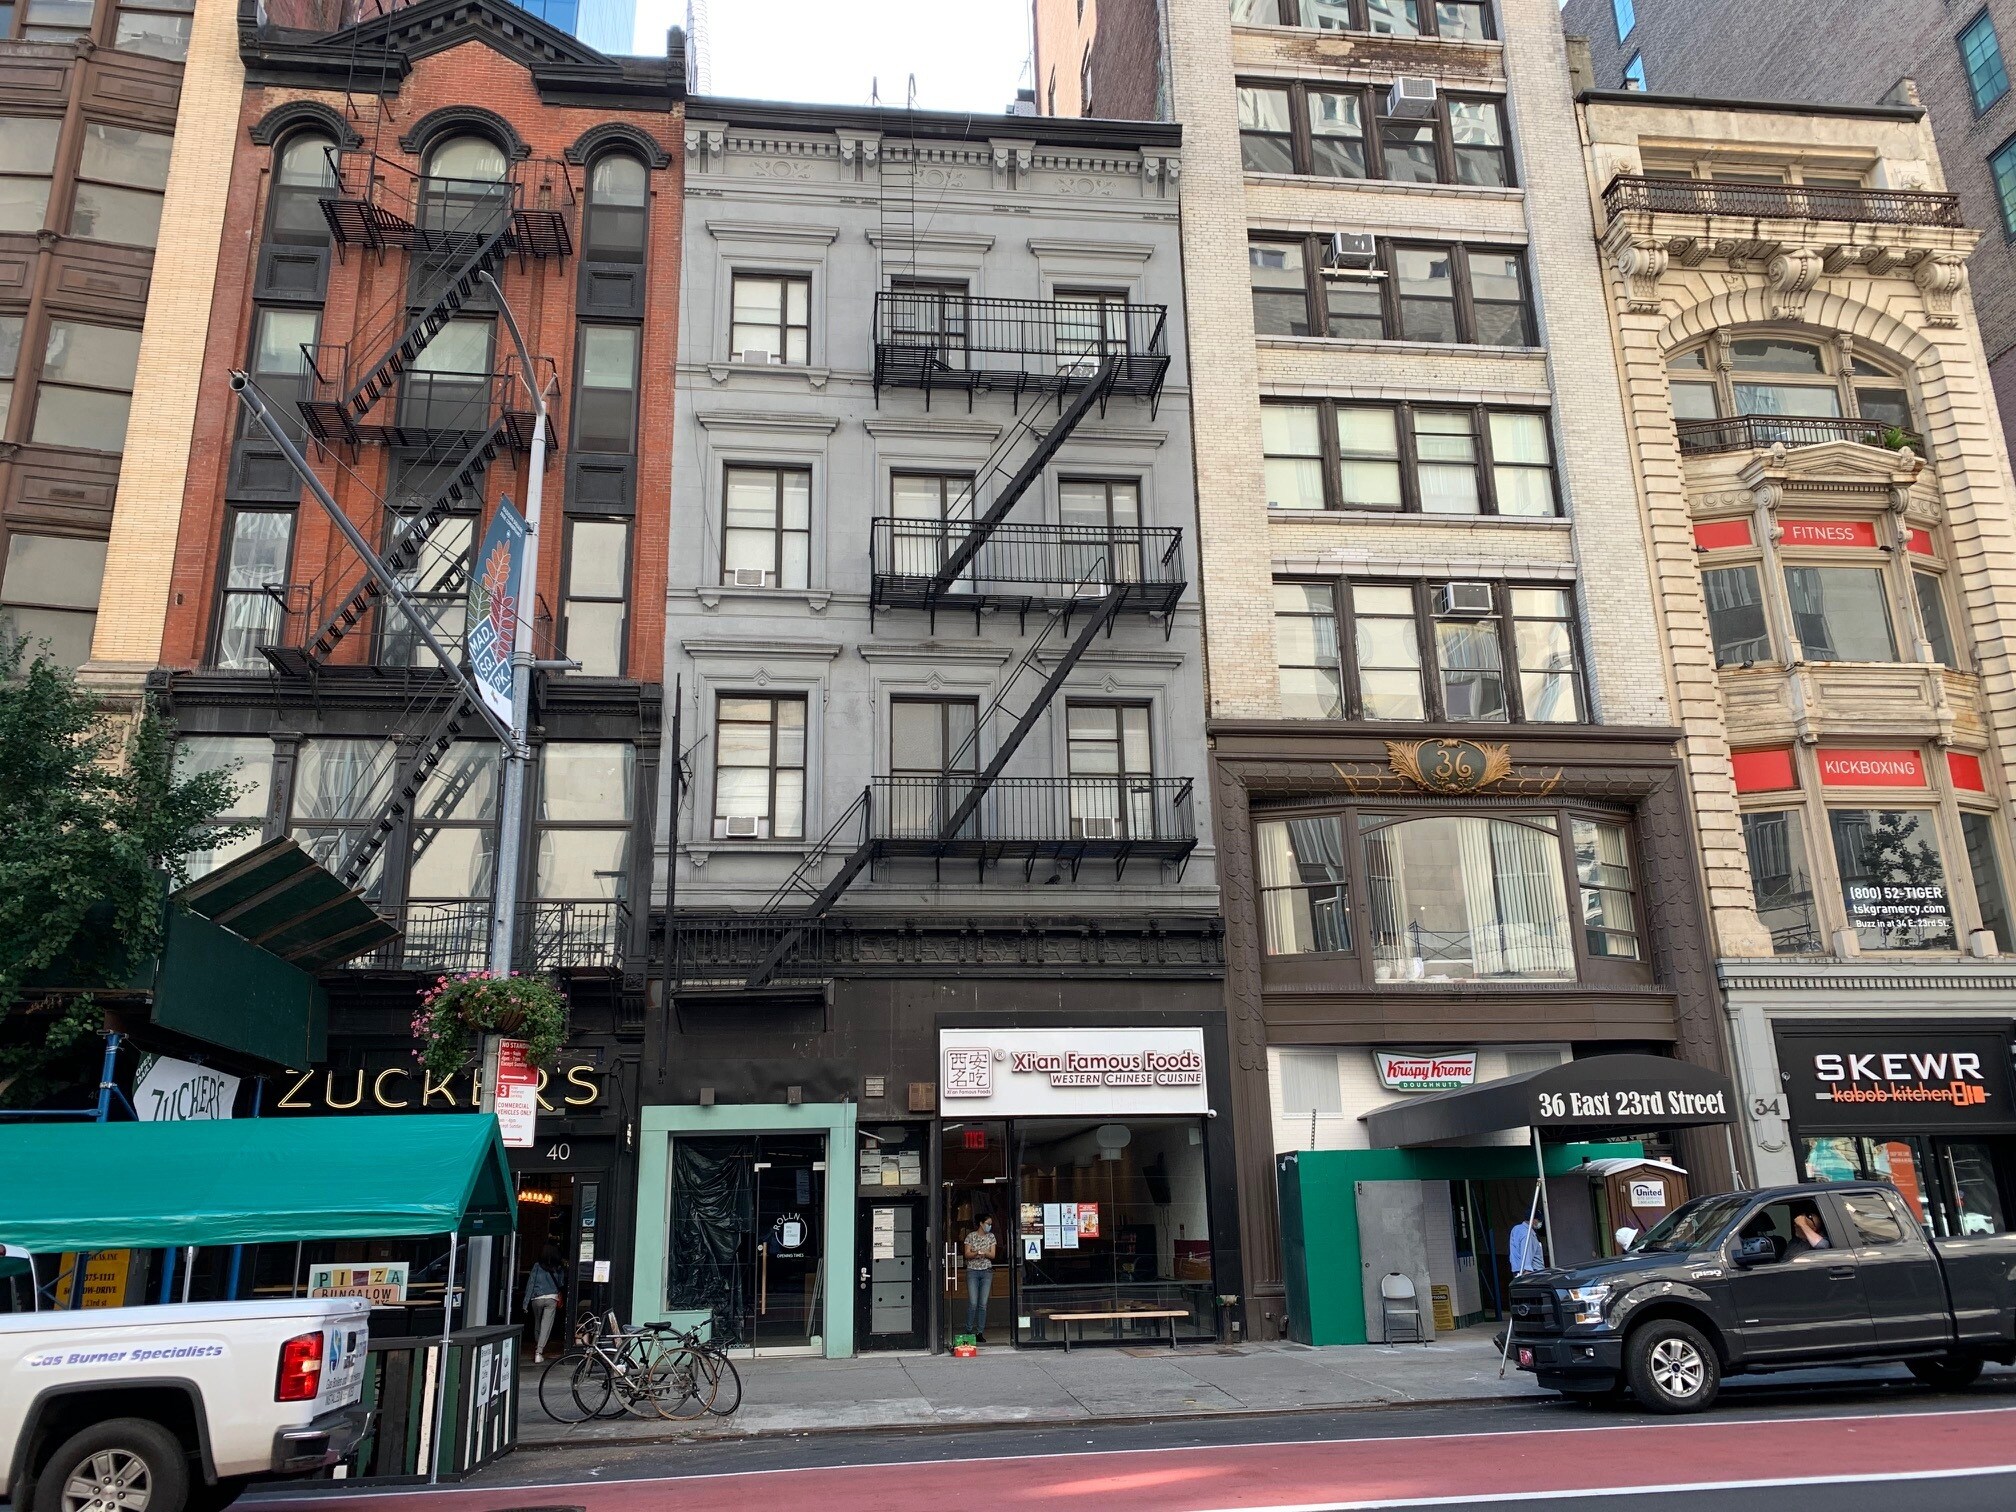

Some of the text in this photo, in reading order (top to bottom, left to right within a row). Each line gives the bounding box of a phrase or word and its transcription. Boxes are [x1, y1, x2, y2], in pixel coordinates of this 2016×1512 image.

[1792, 526, 1854, 540] FITNESS
[469, 626, 493, 656] MAD.
[480, 656, 495, 677] SQ.
[494, 669, 511, 691] PK.
[1436, 750, 1472, 778] 36
[1825, 760, 1915, 775] KICKBOXING
[1850, 886, 1943, 900] (800) 52-TIGER
[1853, 904, 1946, 916] tskgramercy.com
[1856, 920, 1875, 928] Buzz
[1908, 919, 1917, 927] E.
[136, 1053, 152, 1077] OPEN
[949, 1051, 988, 1071] 西安
[1013, 1050, 1202, 1071] Xi'an Famous Foods
[1814, 1053, 1985, 1081] SKEWR
[137, 1058, 153, 1084] DAILY
[949, 1070, 988, 1087] 名吃
[1052, 1073, 1201, 1084] WESTERN CHINESE CUISINE
[1387, 1060, 1473, 1080] Krispy Kreme
[500, 1085, 506, 1096] 3
[1832, 1082, 1952, 1102] kabob kitchen
[498, 1102, 530, 1110] COMMERCIAL
[1538, 1090, 1726, 1118] 36 East 23rd Street
[1754, 1098, 1781, 1116] 34
[546, 1142, 570, 1161] 40
[1636, 1188, 1662, 1197] United
[772, 1212, 800, 1230] ROLLN
[1028, 1242, 1038, 1254] A
[322, 1288, 392, 1300] BUNGALOW
[31, 1345, 224, 1366] Gas Burner Specialists
